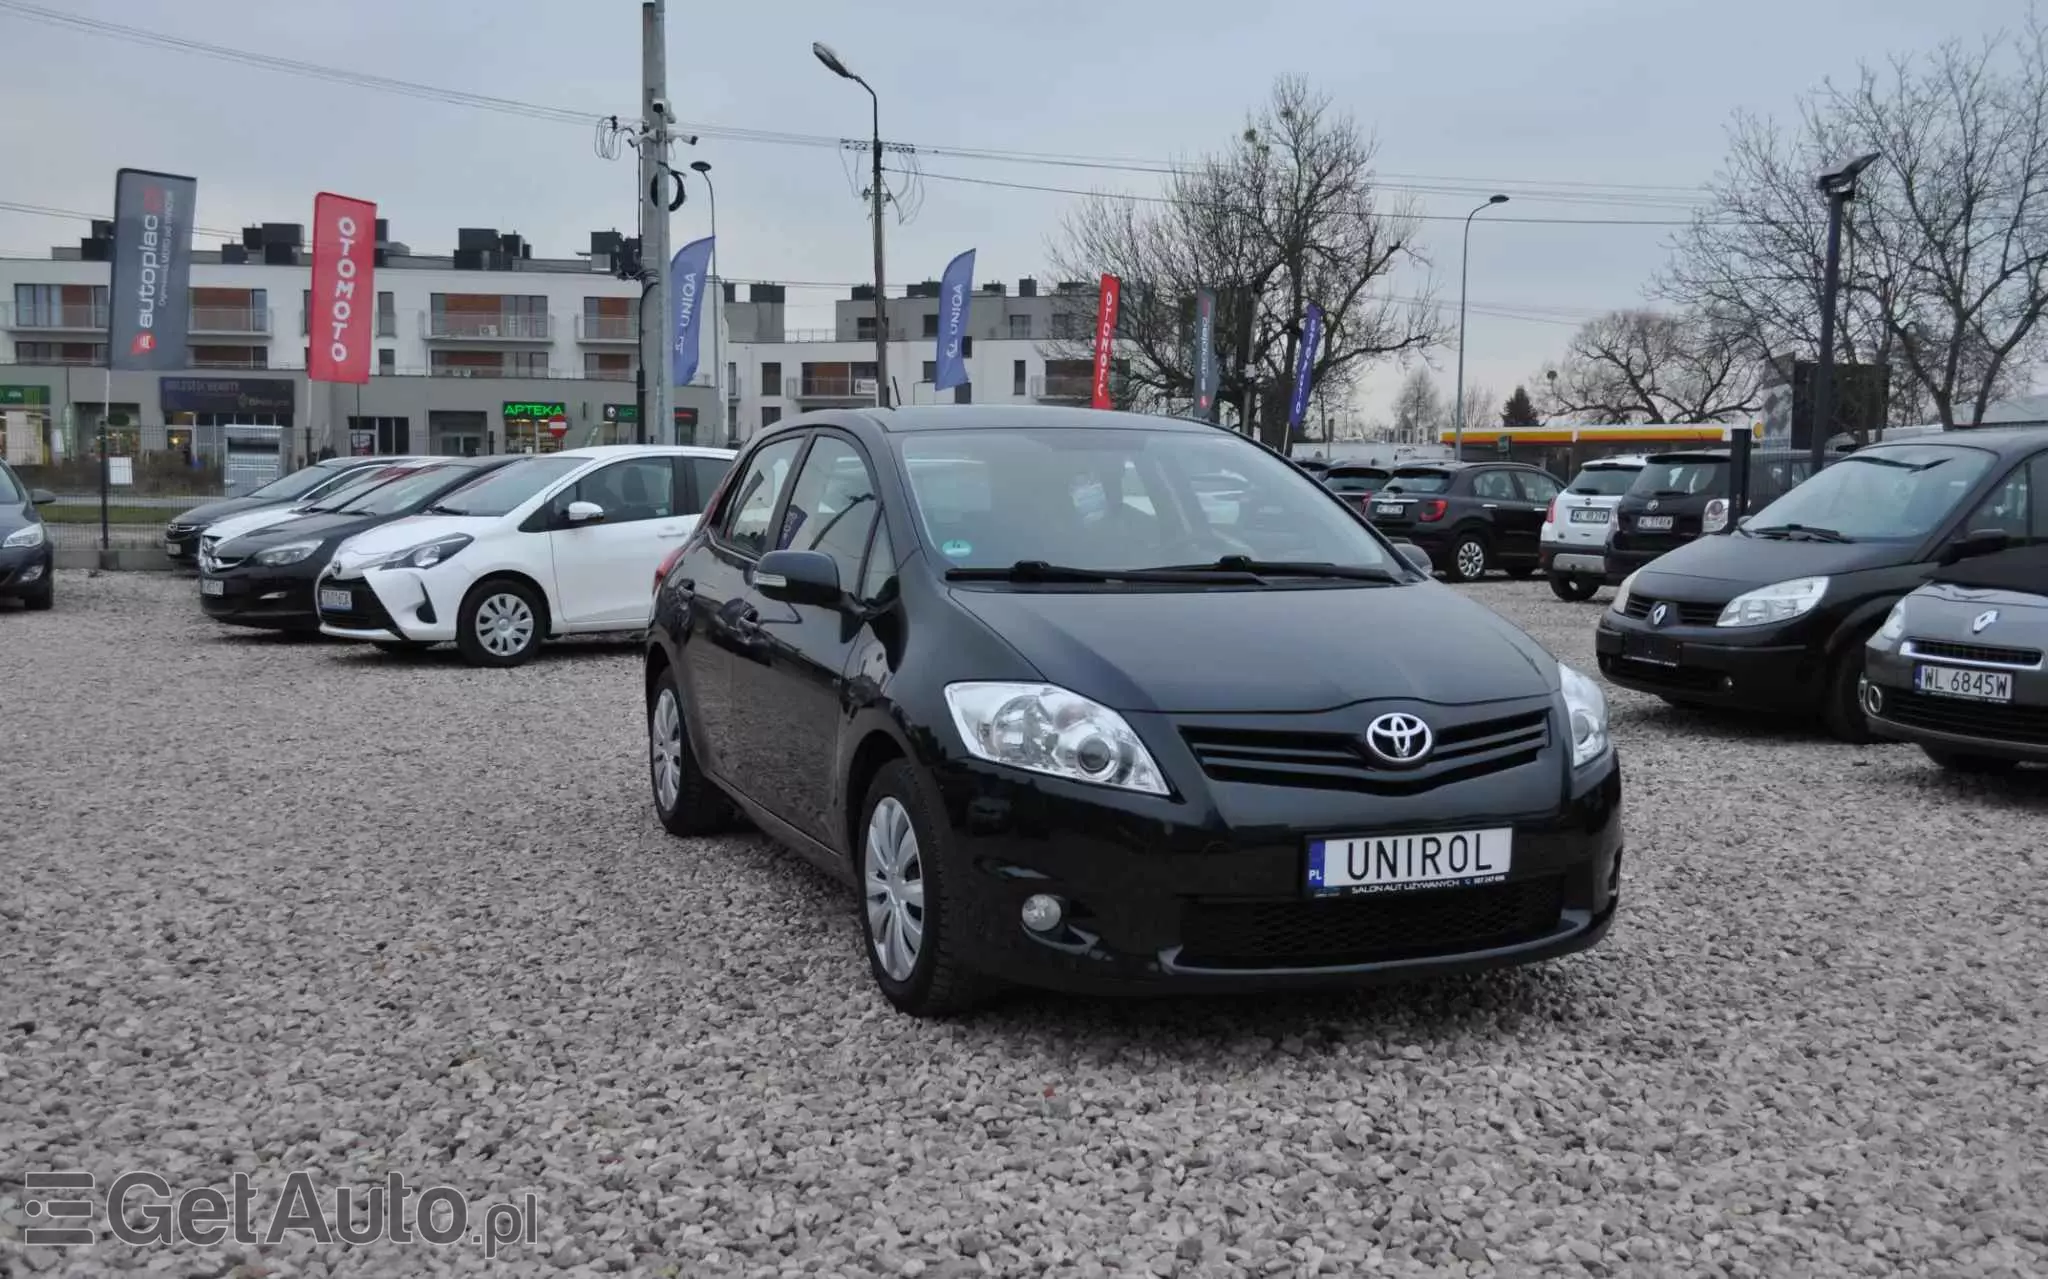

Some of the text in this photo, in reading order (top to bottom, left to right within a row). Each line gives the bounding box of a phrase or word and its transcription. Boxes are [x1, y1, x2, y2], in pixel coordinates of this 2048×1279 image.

[139, 214, 158, 329] autoplac
[333, 216, 357, 363] OTOMOTO
[679, 272, 697, 327] UNIQA
[949, 283, 964, 335] UNIQA
[504, 403, 564, 417] APTEKA
[1924, 667, 2008, 697] WL 6845W
[1308, 869, 1323, 881] PL
[1347, 832, 1492, 881] UNIROL
[1351, 885, 1384, 895] SALON
